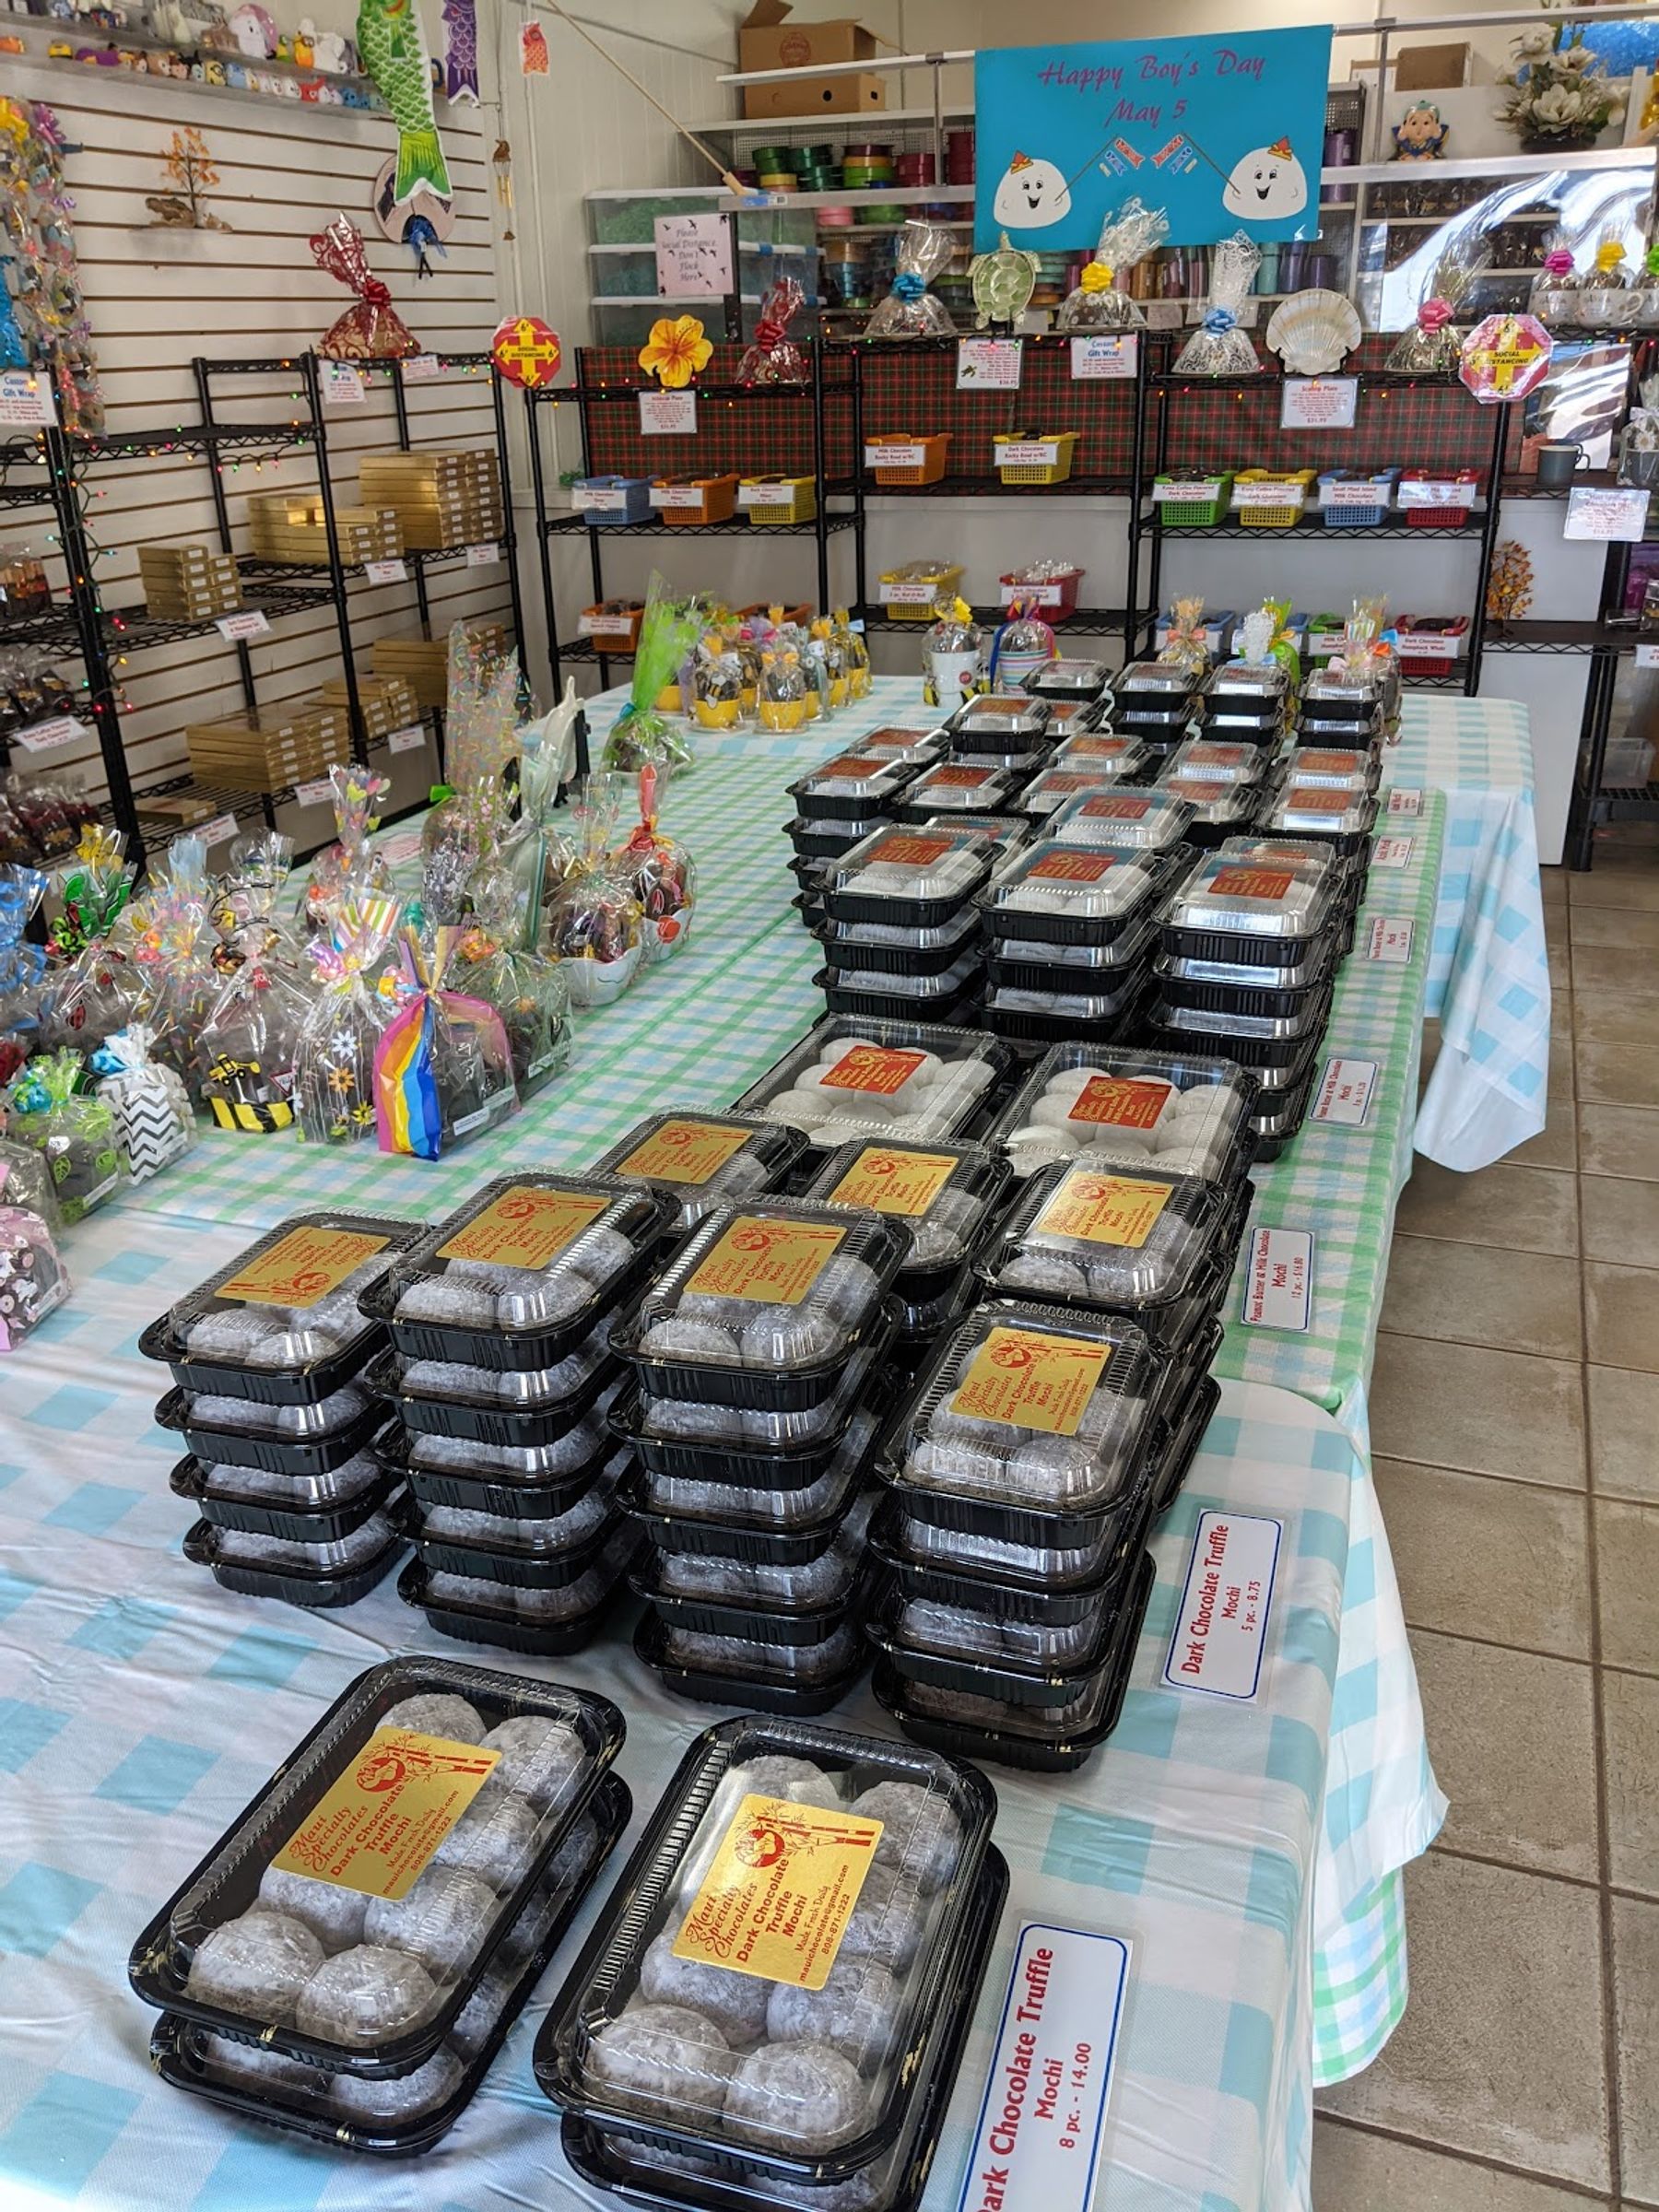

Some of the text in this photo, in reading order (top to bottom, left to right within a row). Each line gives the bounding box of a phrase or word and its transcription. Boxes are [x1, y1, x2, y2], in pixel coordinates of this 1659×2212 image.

[1037, 50, 1265, 92] Happy Boy's Day
[1104, 99, 1187, 128] May 5
[483, 1244, 502, 1259] Dark
[1257, 1230, 1271, 1256] Chocolate
[734, 1247, 773, 1295] Dark Chocolate
[768, 1262, 788, 1283] Mochi
[1255, 1258, 1267, 1271] Milk
[1271, 1263, 1288, 1288] Mochi
[1253, 1279, 1265, 1300] Butter
[1291, 1290, 1301, 1299] 12
[1250, 1301, 1264, 1323] Peanut
[959, 1382, 981, 1408] Maui
[975, 1376, 998, 1413] Specialty
[982, 1375, 1013, 1417] Chocolates
[1002, 1363, 1037, 1419] Dark Chocolate
[1022, 1381, 1041, 1406] Truffle
[1036, 1383, 1053, 1406] Mochi
[1181, 1524, 1230, 1674] Dark Chocolate Truffle
[1221, 1585, 1241, 1619] Mochi
[1246, 1580, 1261, 1601] 8.75
[1247, 1610, 1257, 1624] pc.
[288, 1814, 329, 1858] Maui
[300, 1805, 353, 1867] Specialty
[312, 1804, 370, 1873] Chocolates
[330, 1783, 405, 1877] Dark Chocolate
[363, 1811, 399, 1853] Truffle
[379, 1816, 413, 1855] Mochi
[685, 1894, 718, 1945] Maui
[699, 1883, 742, 1953] Specialty
[713, 1882, 759, 1959] Chocolates
[735, 1857, 789, 1963] Dark Chocolate
[765, 1889, 794, 1935] Truffle
[782, 1894, 808, 1938] Mochi
[821, 1893, 852, 1956] 808-871-1222
[988, 2032, 1037, 2156] Chocolate
[1016, 1947, 1054, 2023] Truffle
[1070, 2041, 1093, 2088] 14.00
[1034, 2058, 1065, 2120] Mochi
[1065, 2107, 1081, 2134] pc.
[1059, 2136, 1076, 2149] 8
